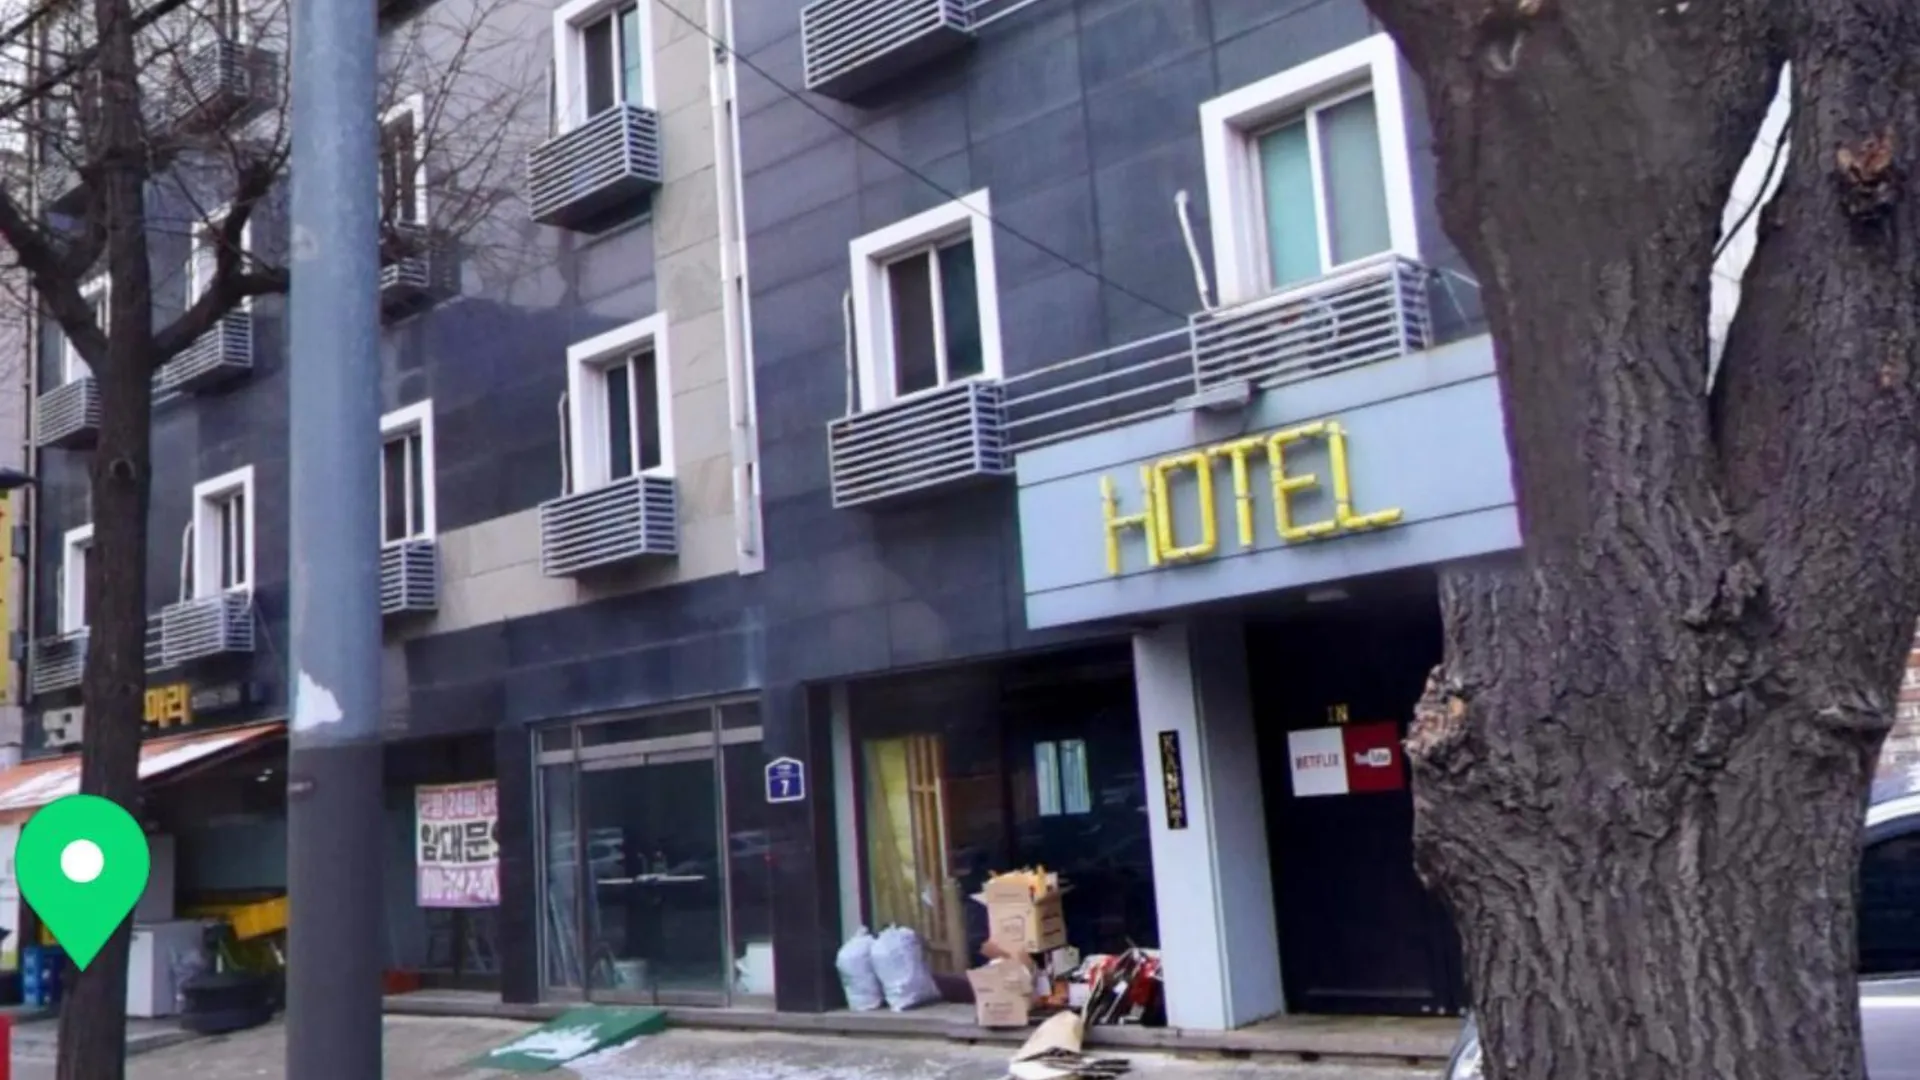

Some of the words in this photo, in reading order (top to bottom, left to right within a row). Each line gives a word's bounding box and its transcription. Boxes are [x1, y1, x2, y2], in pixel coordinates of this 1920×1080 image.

[1100, 420, 1403, 575] HOTEL
[1295, 752, 1340, 771] NETFLIX
[1353, 747, 1392, 767] YouTube
[780, 780, 790, 797] 7
[420, 820, 499, 864] 임대문
